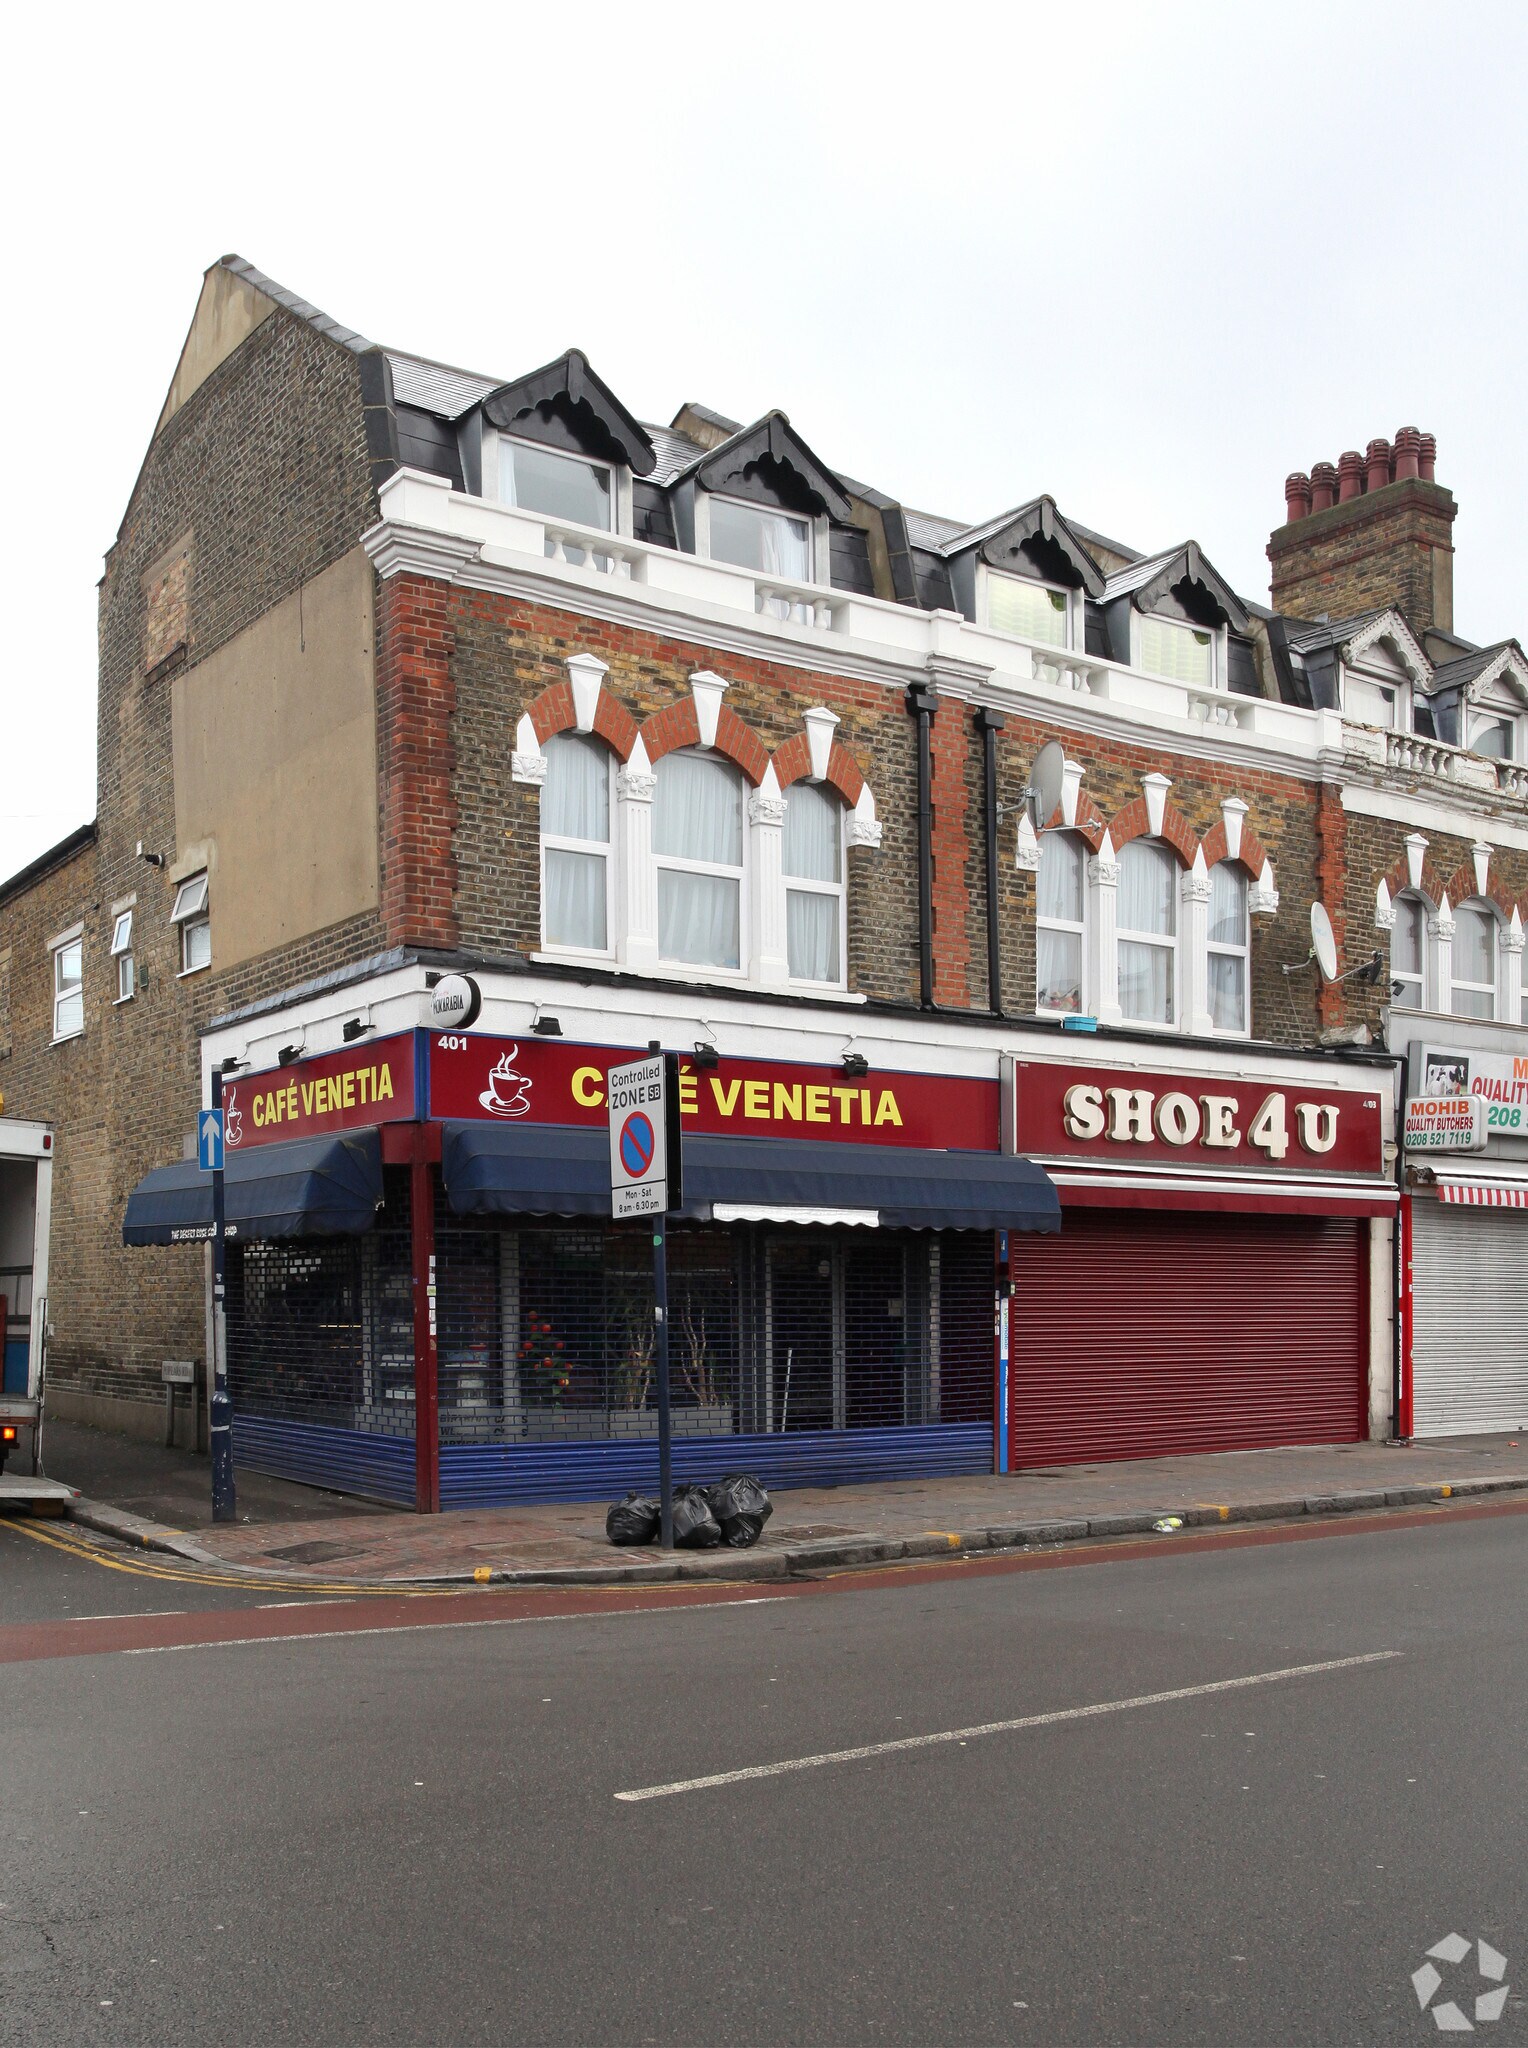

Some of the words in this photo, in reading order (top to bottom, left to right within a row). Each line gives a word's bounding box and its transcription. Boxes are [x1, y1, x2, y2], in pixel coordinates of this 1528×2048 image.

[437, 1035, 467, 1051] 401
[611, 1063, 660, 1088] Controlled
[252, 1078, 299, 1128] CAFÉ
[300, 1063, 394, 1116] VENETIA
[571, 1065, 699, 1114] CÉ
[709, 1077, 904, 1127] VENETIA
[612, 1086, 646, 1110] ZONE
[648, 1085, 660, 1100] SB
[1471, 1076, 1528, 1105] QUALIT
[1410, 1100, 1470, 1116] MOHIB
[1063, 1084, 1242, 1149] SHOE
[1247, 1091, 1289, 1161] 4
[1294, 1102, 1341, 1155] U
[1405, 1117, 1436, 1132] QUALITY
[1436, 1116, 1474, 1131] BUTCHERS
[1405, 1132, 1428, 1147] 0208
[1429, 1132, 1446, 1146] 521
[1449, 1131, 1472, 1145] 7119
[625, 1190, 638, 1199] Mon
[641, 1188, 652, 1197] Sat
